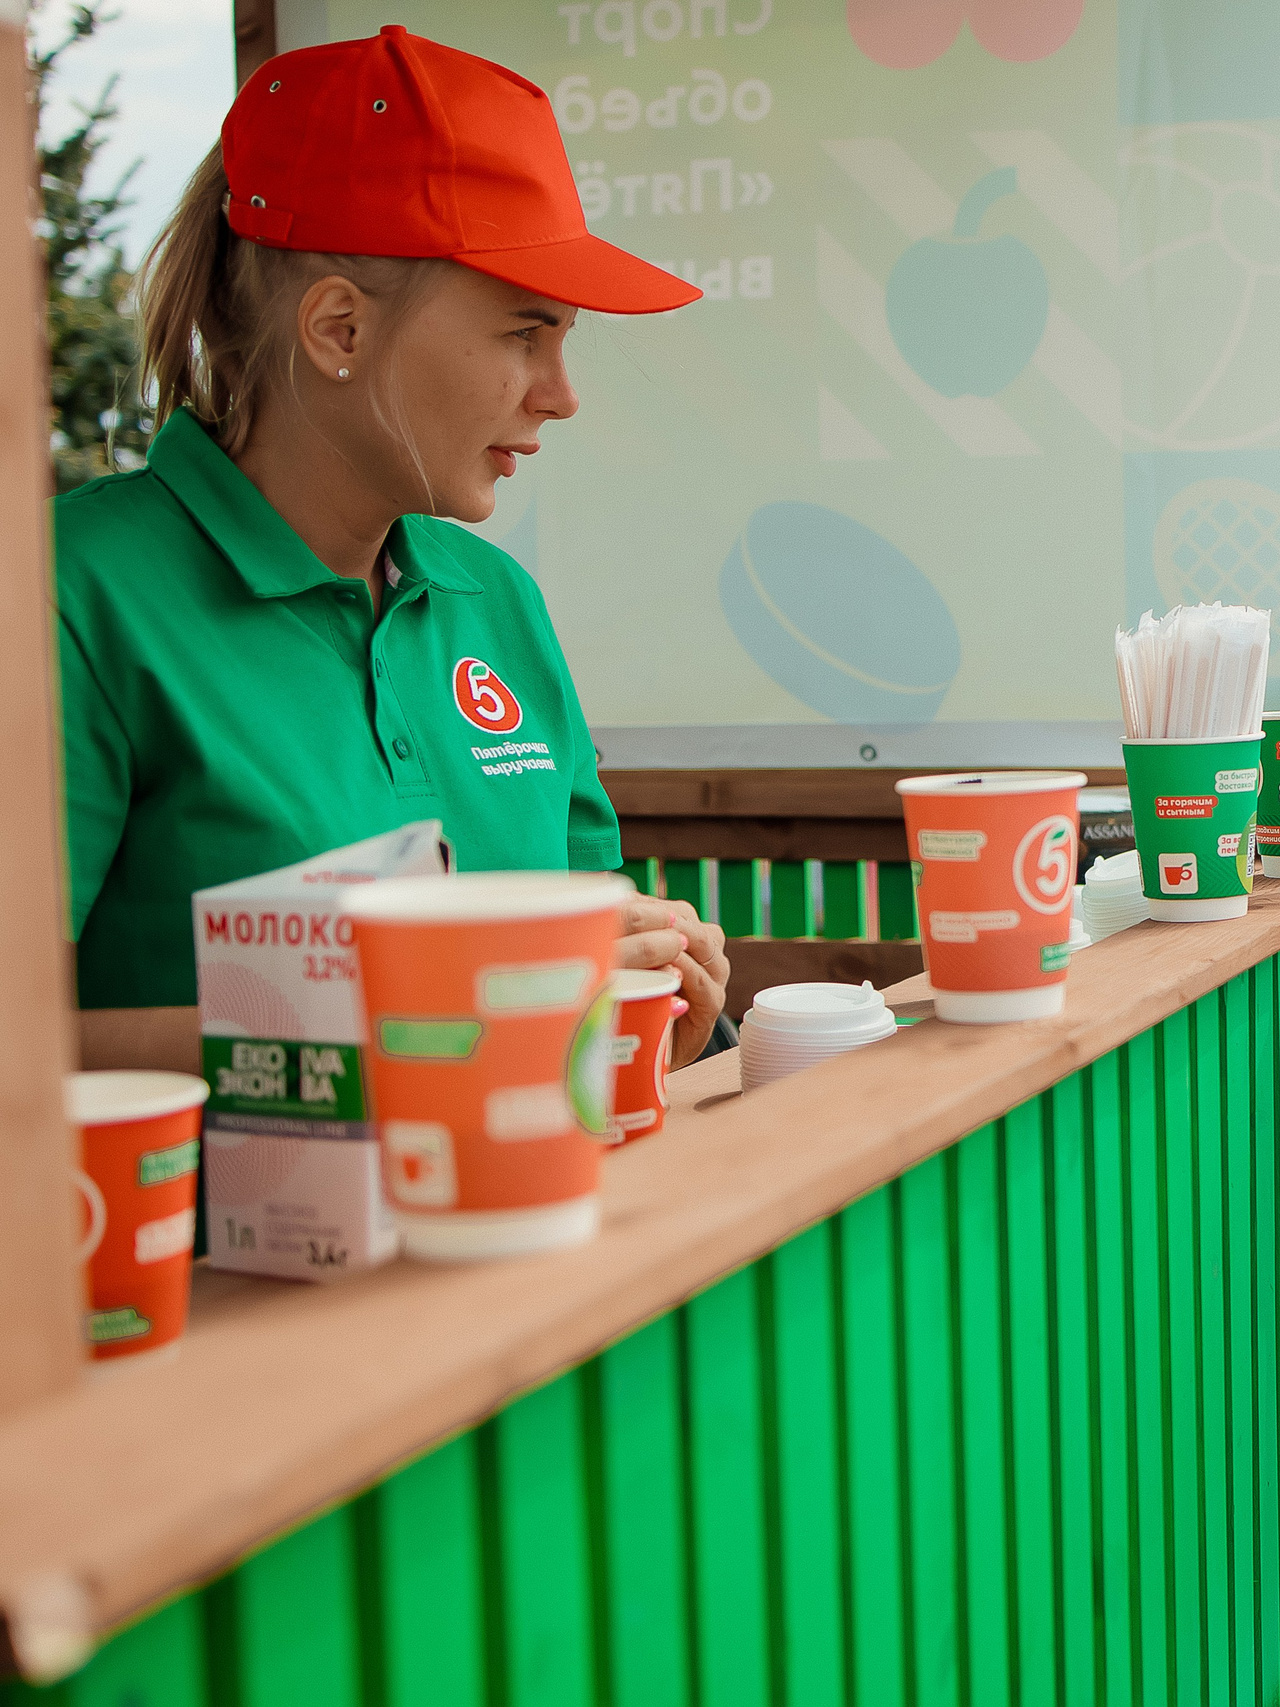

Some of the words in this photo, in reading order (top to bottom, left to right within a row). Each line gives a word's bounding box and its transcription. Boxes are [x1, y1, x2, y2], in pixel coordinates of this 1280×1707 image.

[470, 741, 550, 760] Пятёрочка
[481, 758, 557, 776] выручает!
[1219, 773, 1229, 781] За
[1157, 798, 1169, 807] За
[1170, 798, 1213, 808] горячим
[1166, 808, 1205, 816] сытным
[204, 911, 357, 947] МОЛОКО
